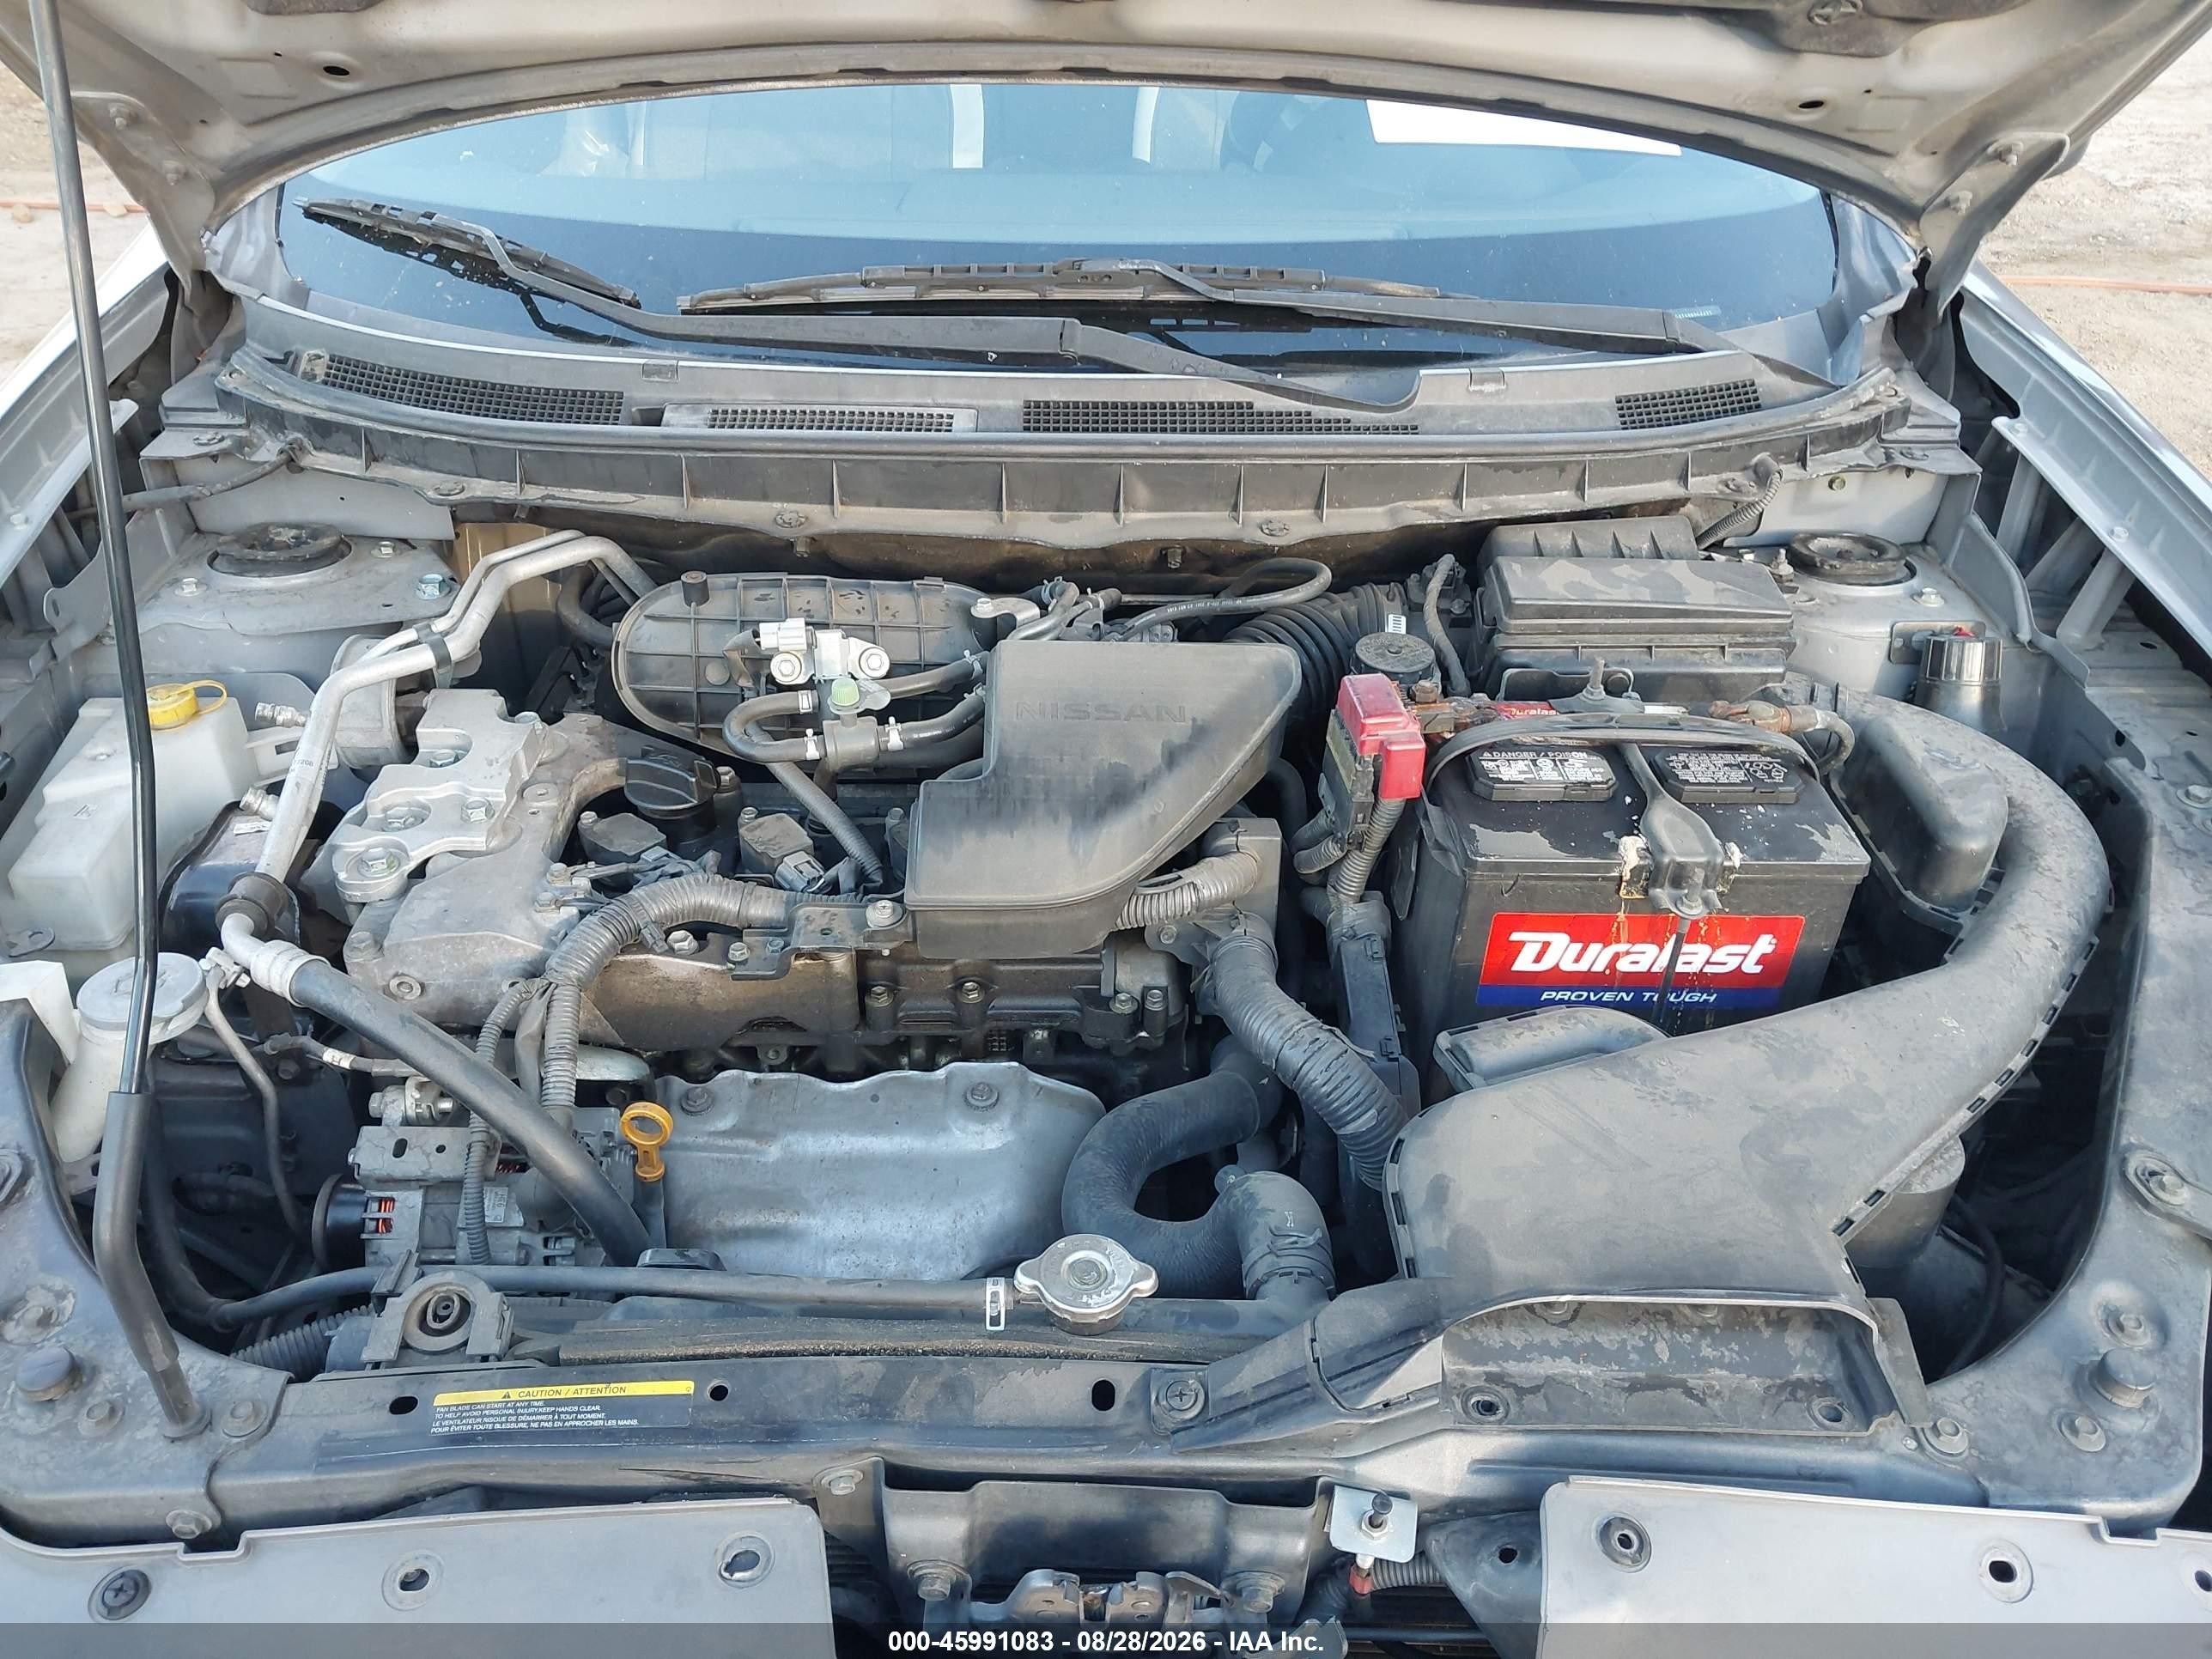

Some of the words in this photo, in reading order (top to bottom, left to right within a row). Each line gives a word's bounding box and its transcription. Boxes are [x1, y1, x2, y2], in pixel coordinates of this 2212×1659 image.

[1015, 702, 1187, 722] NISSAN
[1505, 707, 1560, 715] uralas
[1508, 931, 1778, 974] Duralast
[1540, 991, 1634, 1002] PROVEN
[1642, 991, 1717, 1003] TUGH
[518, 1389, 562, 1398] CAUTION
[573, 1386, 627, 1395] ATTENTION
[441, 1418, 483, 1426] VENTILATEUR
